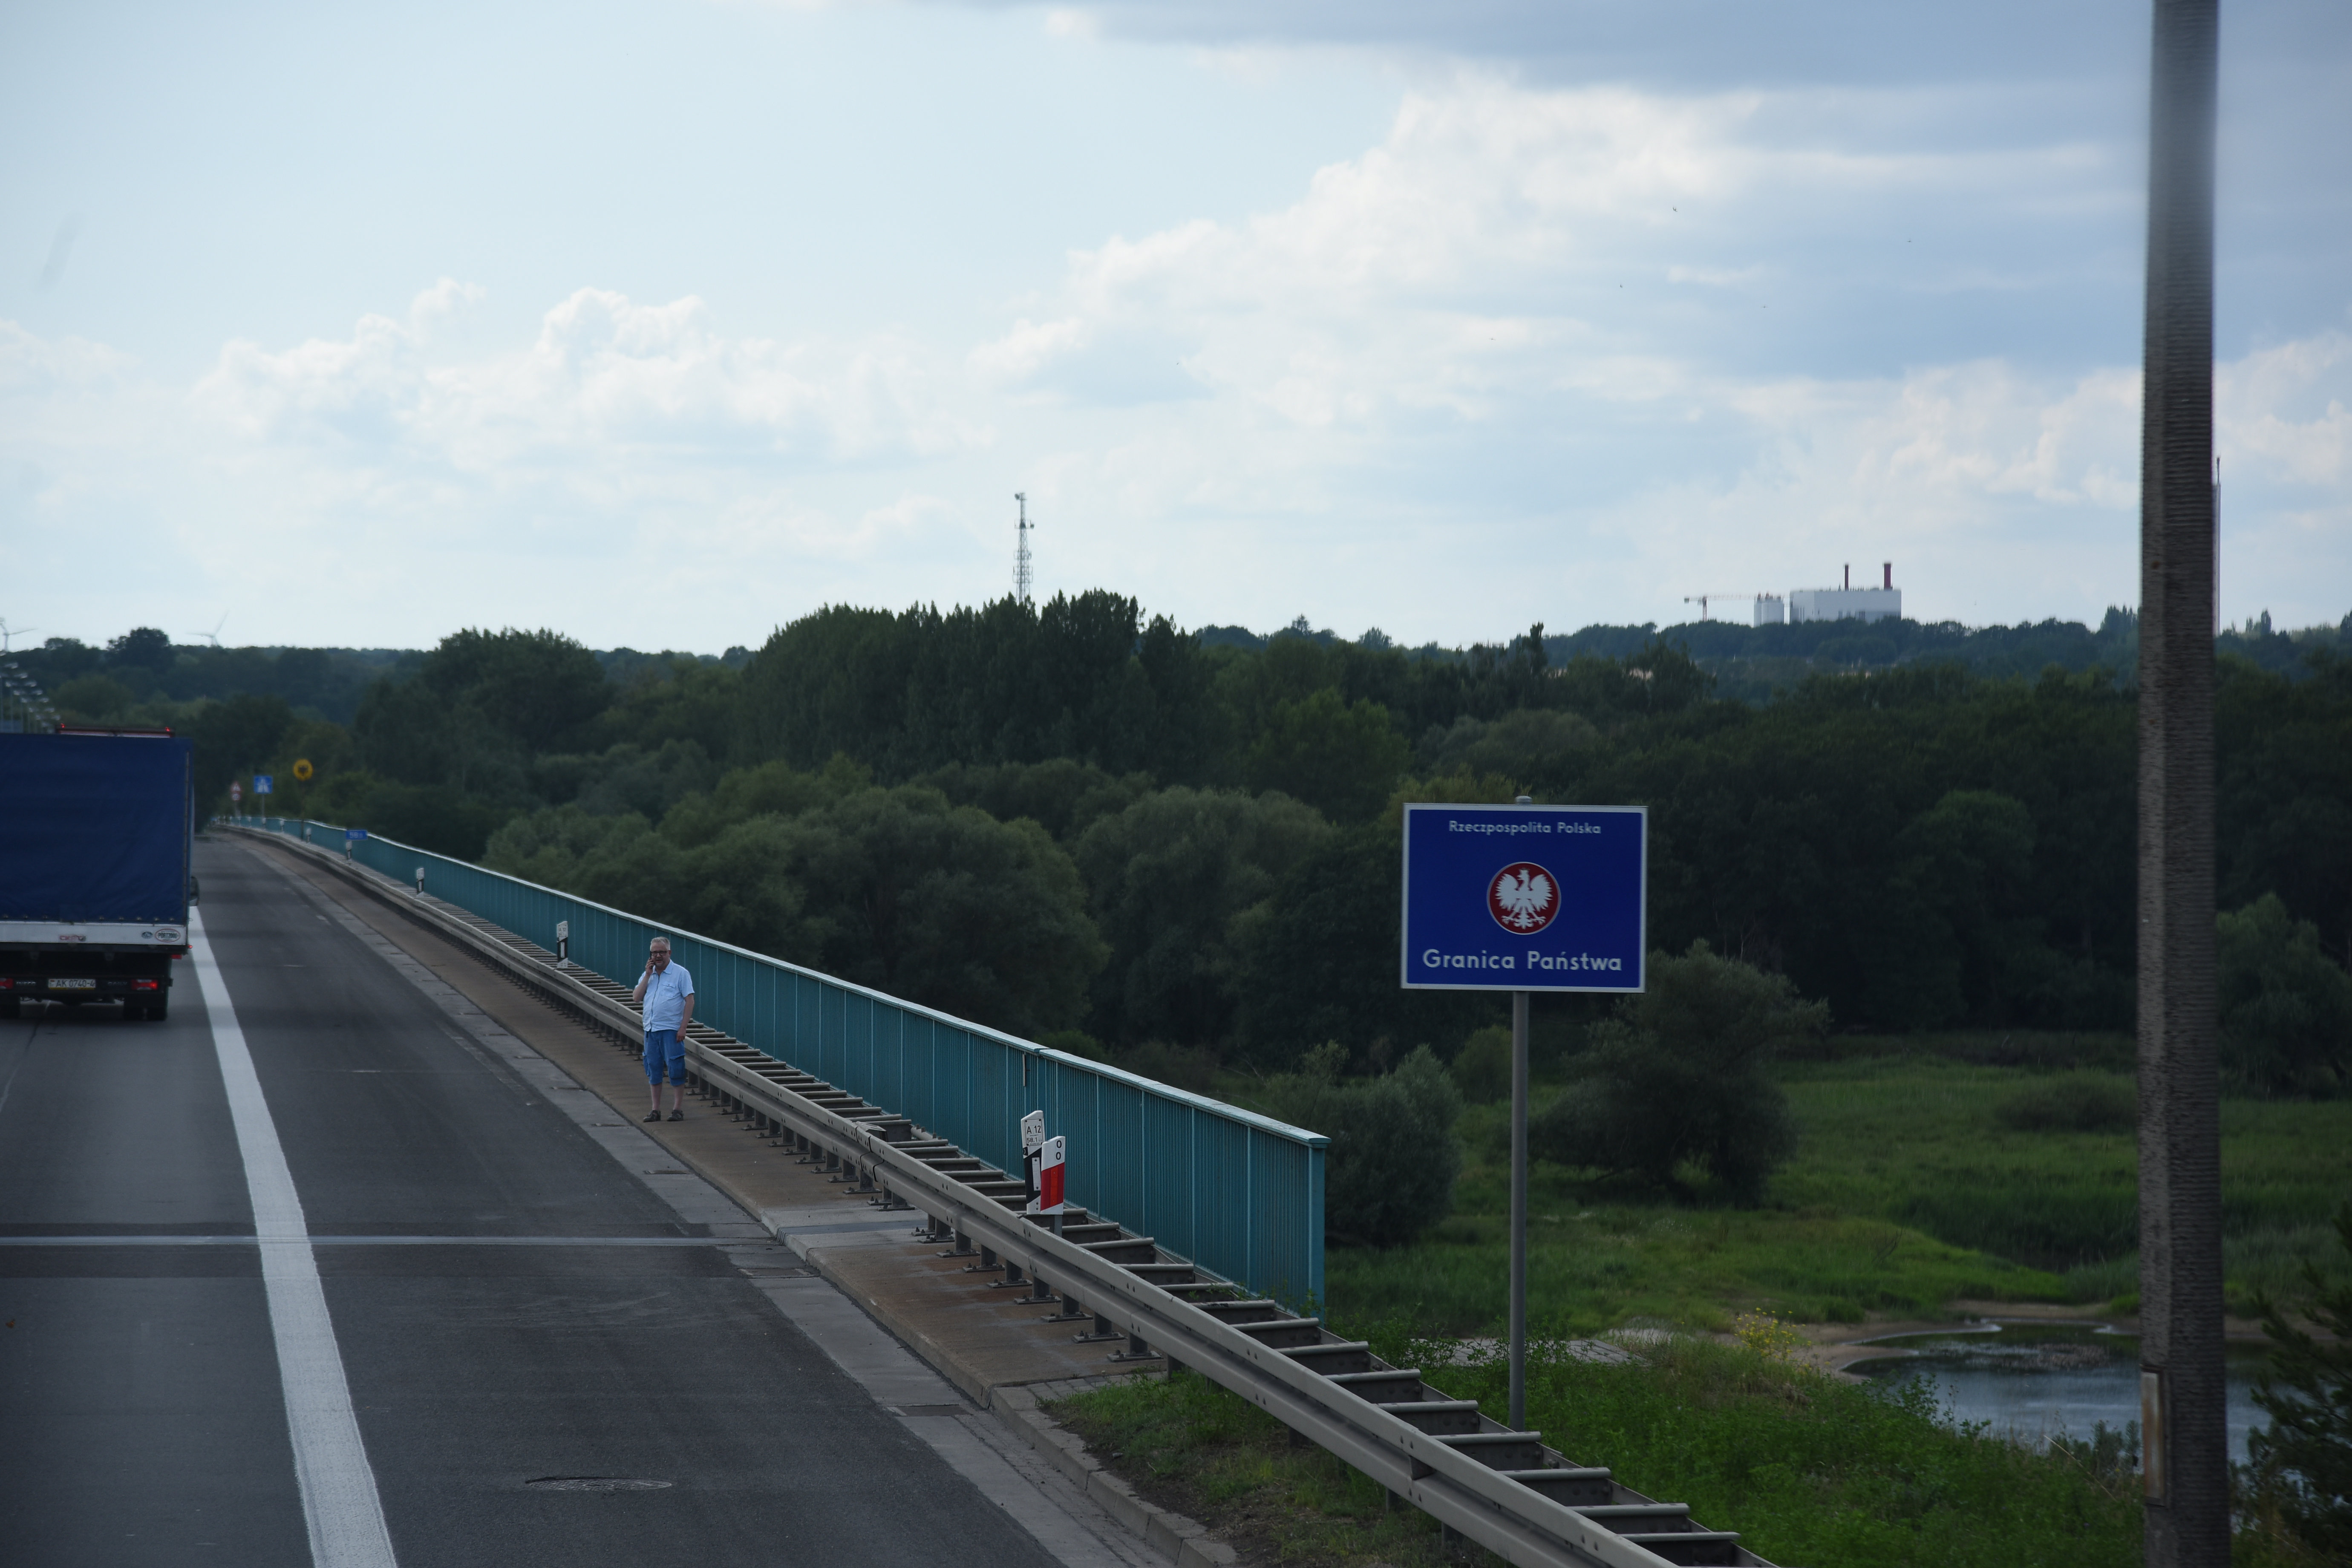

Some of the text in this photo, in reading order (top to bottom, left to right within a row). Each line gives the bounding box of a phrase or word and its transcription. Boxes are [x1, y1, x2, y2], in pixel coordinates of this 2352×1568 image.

[1448, 820, 1602, 836] Rzeczpospolita Polska
[1422, 948, 1622, 971] Granica Państwa
[1027, 1125, 1041, 1134] A 12
[1057, 1140, 1062, 1148] 0
[1056, 1152, 1061, 1160] 0
